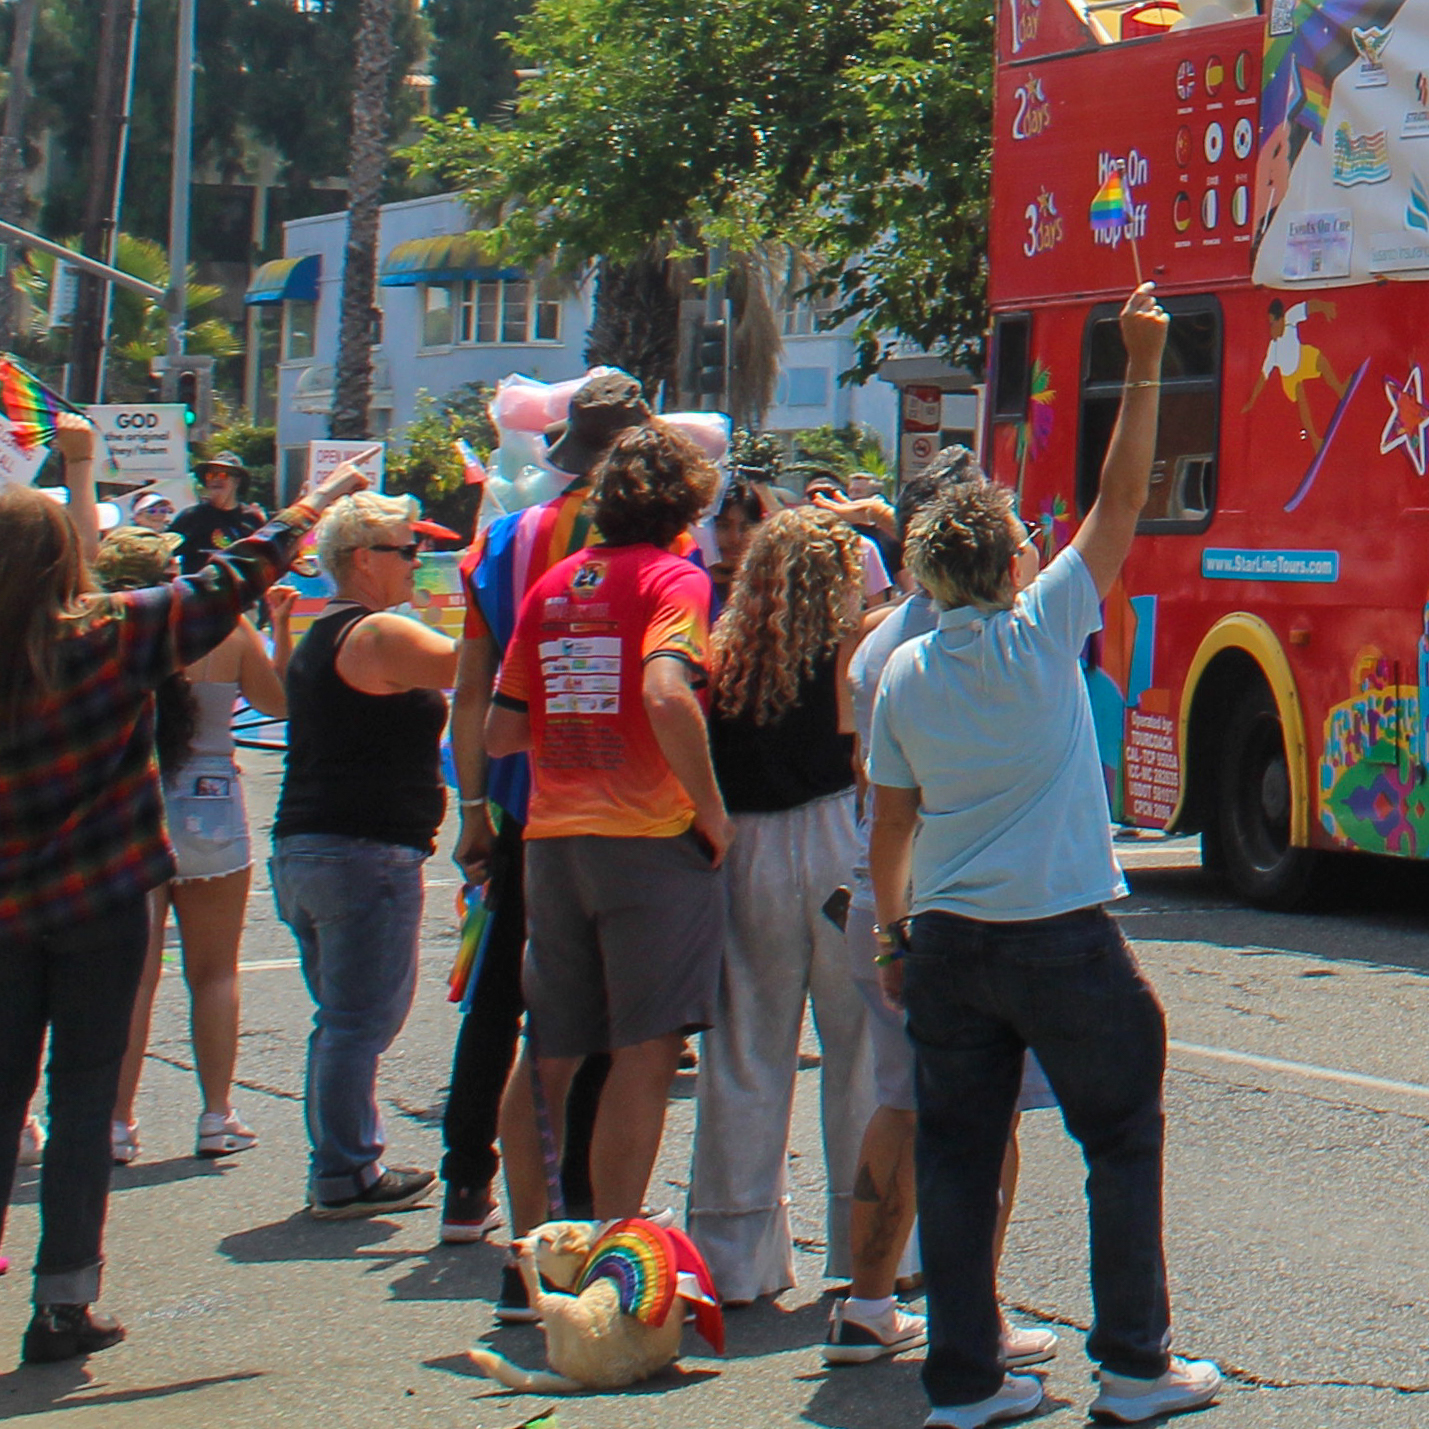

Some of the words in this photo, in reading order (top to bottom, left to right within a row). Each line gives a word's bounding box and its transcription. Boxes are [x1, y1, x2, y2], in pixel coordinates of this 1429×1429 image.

[1023, 102, 1050, 137] days
[1099, 152, 1126, 187] Ho
[1128, 149, 1148, 187] On
[1023, 204, 1038, 257] 3
[1036, 217, 1063, 253] days
[116, 413, 158, 429] GOD
[126, 430, 170, 444] original
[1205, 554, 1333, 576] www.StarLineTours.com
